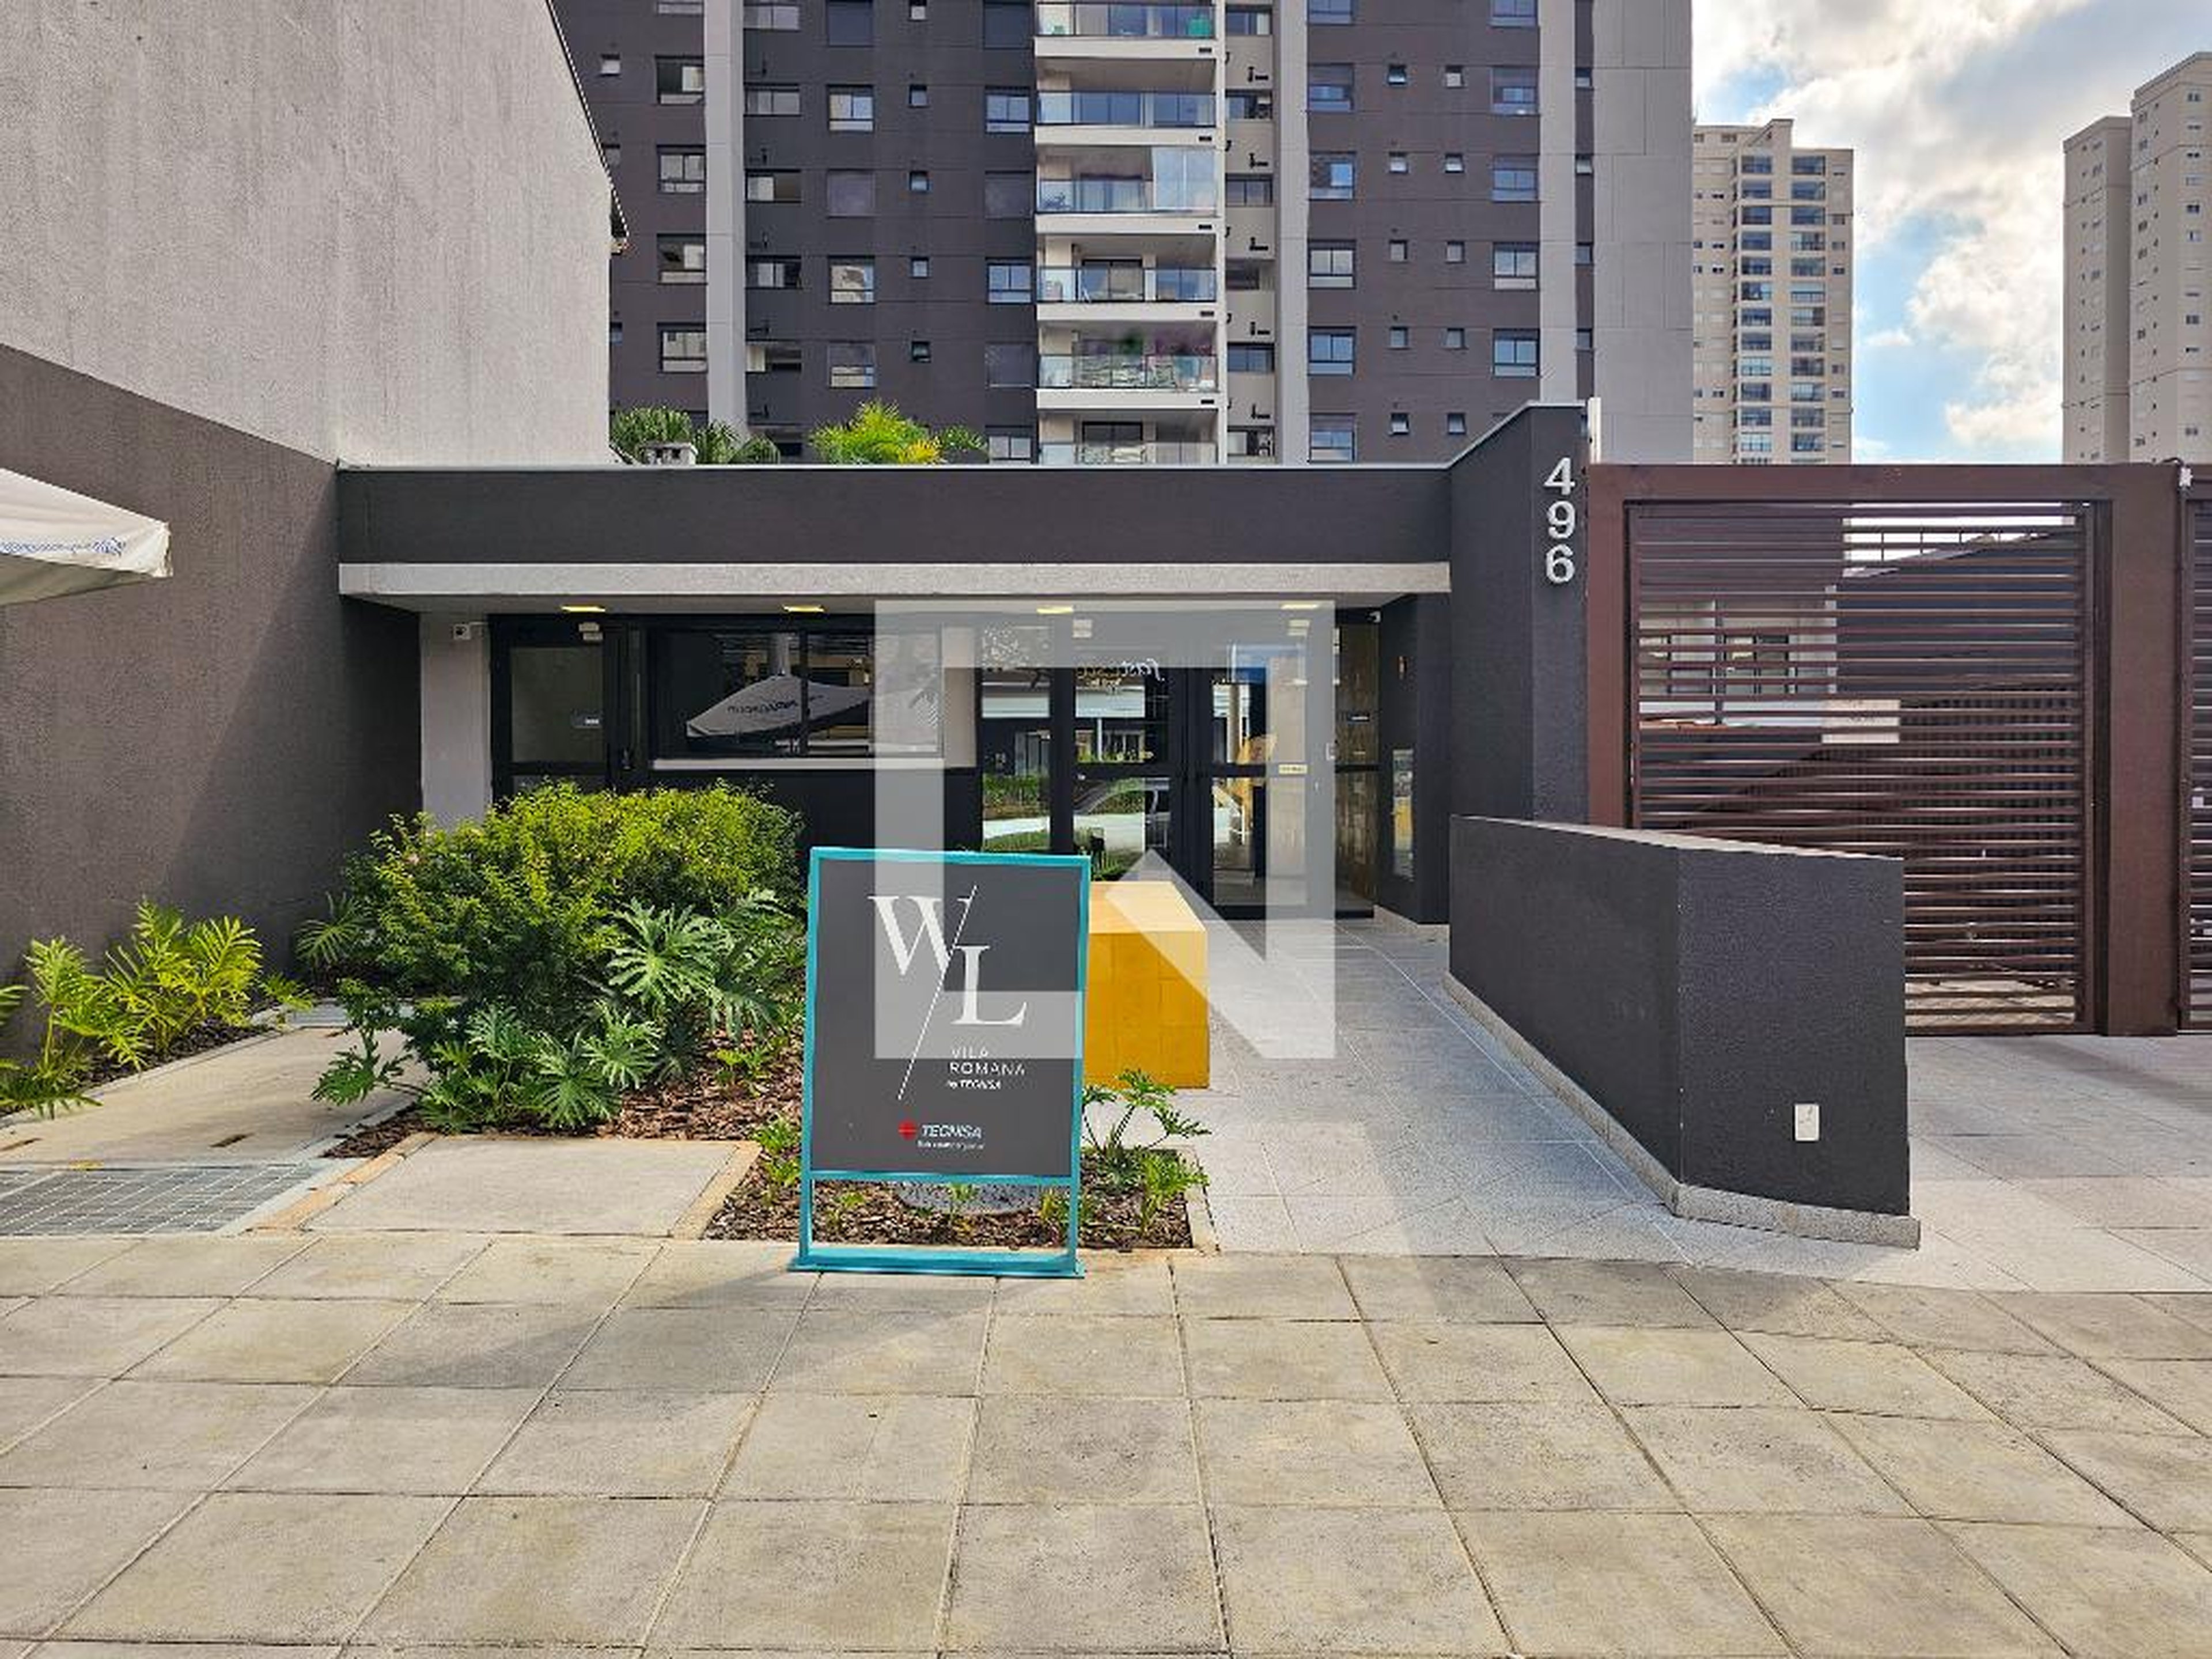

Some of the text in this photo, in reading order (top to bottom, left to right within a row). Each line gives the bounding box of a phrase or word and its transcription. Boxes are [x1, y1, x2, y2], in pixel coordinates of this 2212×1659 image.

[1543, 457, 1576, 584] 496
[952, 1045, 990, 1060] VILA
[949, 1061, 1026, 1076] ROMANA
